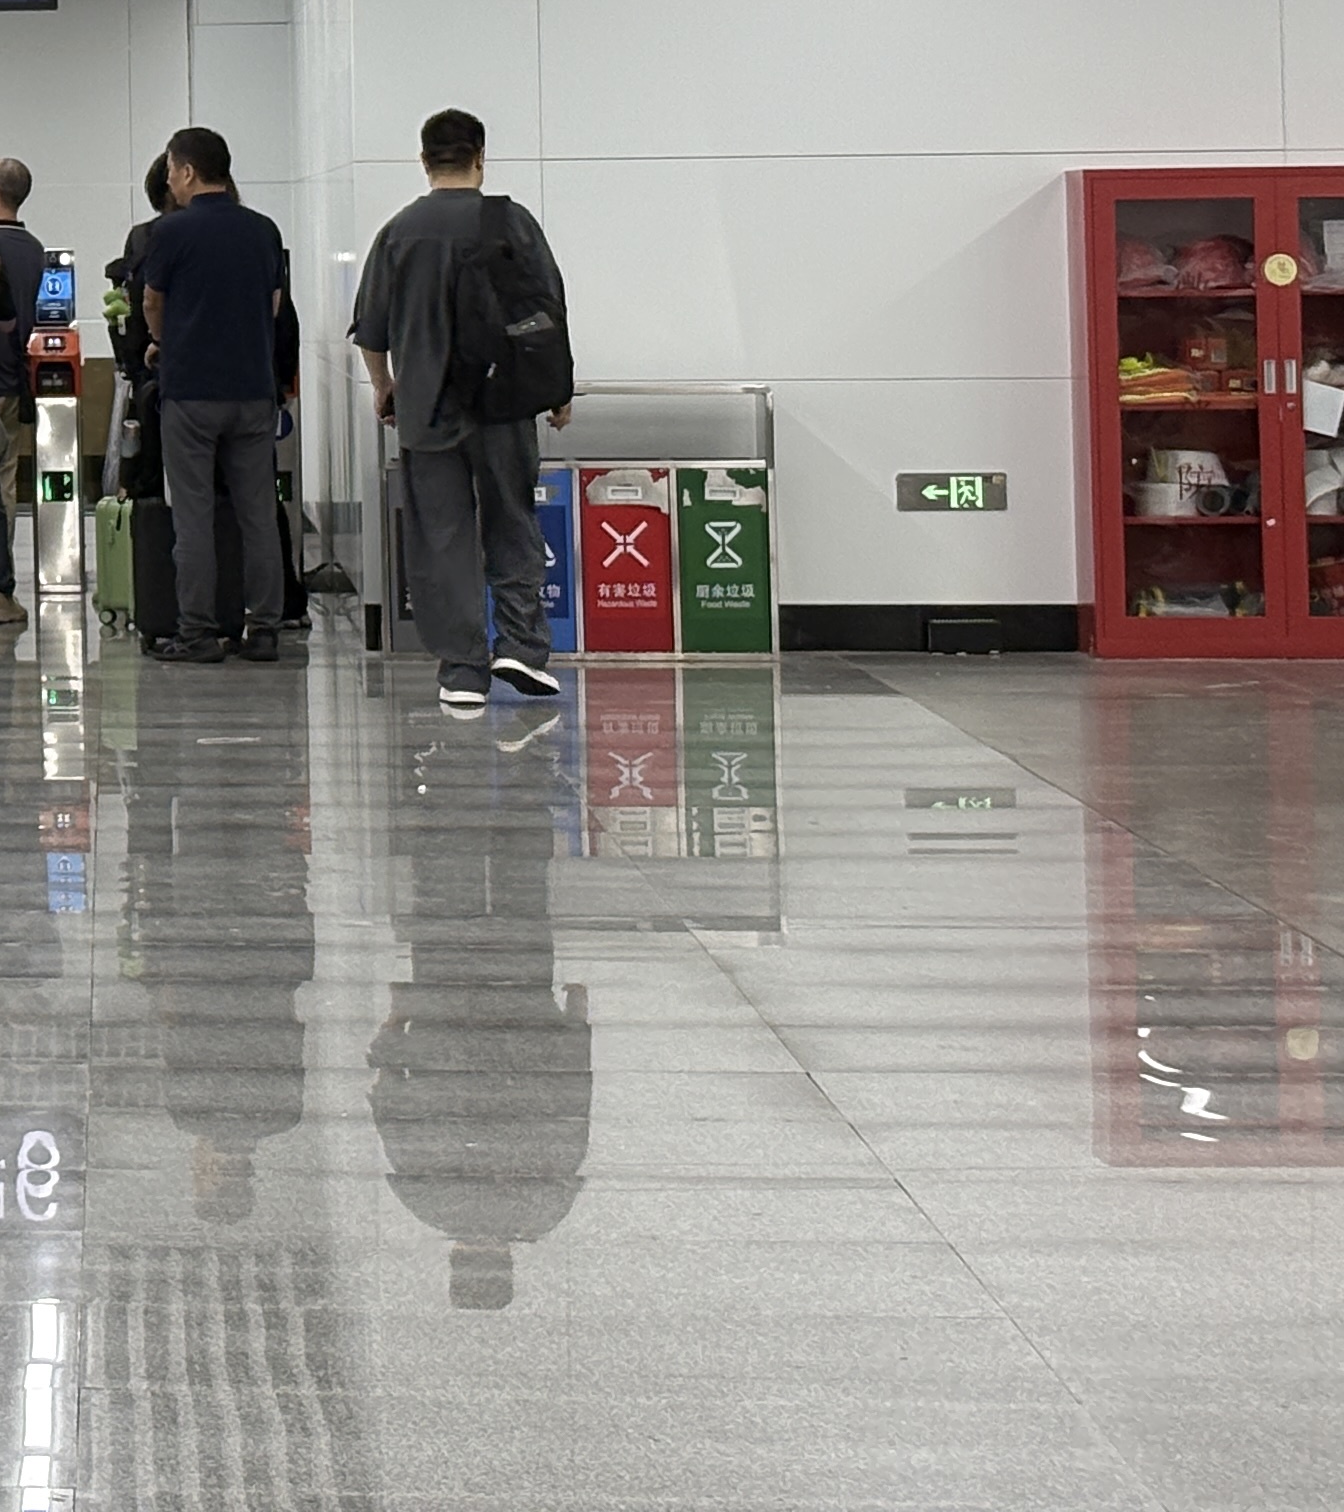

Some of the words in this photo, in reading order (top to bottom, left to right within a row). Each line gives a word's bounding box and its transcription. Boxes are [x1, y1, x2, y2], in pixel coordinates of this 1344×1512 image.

[597, 583, 656, 599] 有害垃圾
[696, 584, 755, 599] 厨余垃圾
[701, 600, 722, 609] Food
